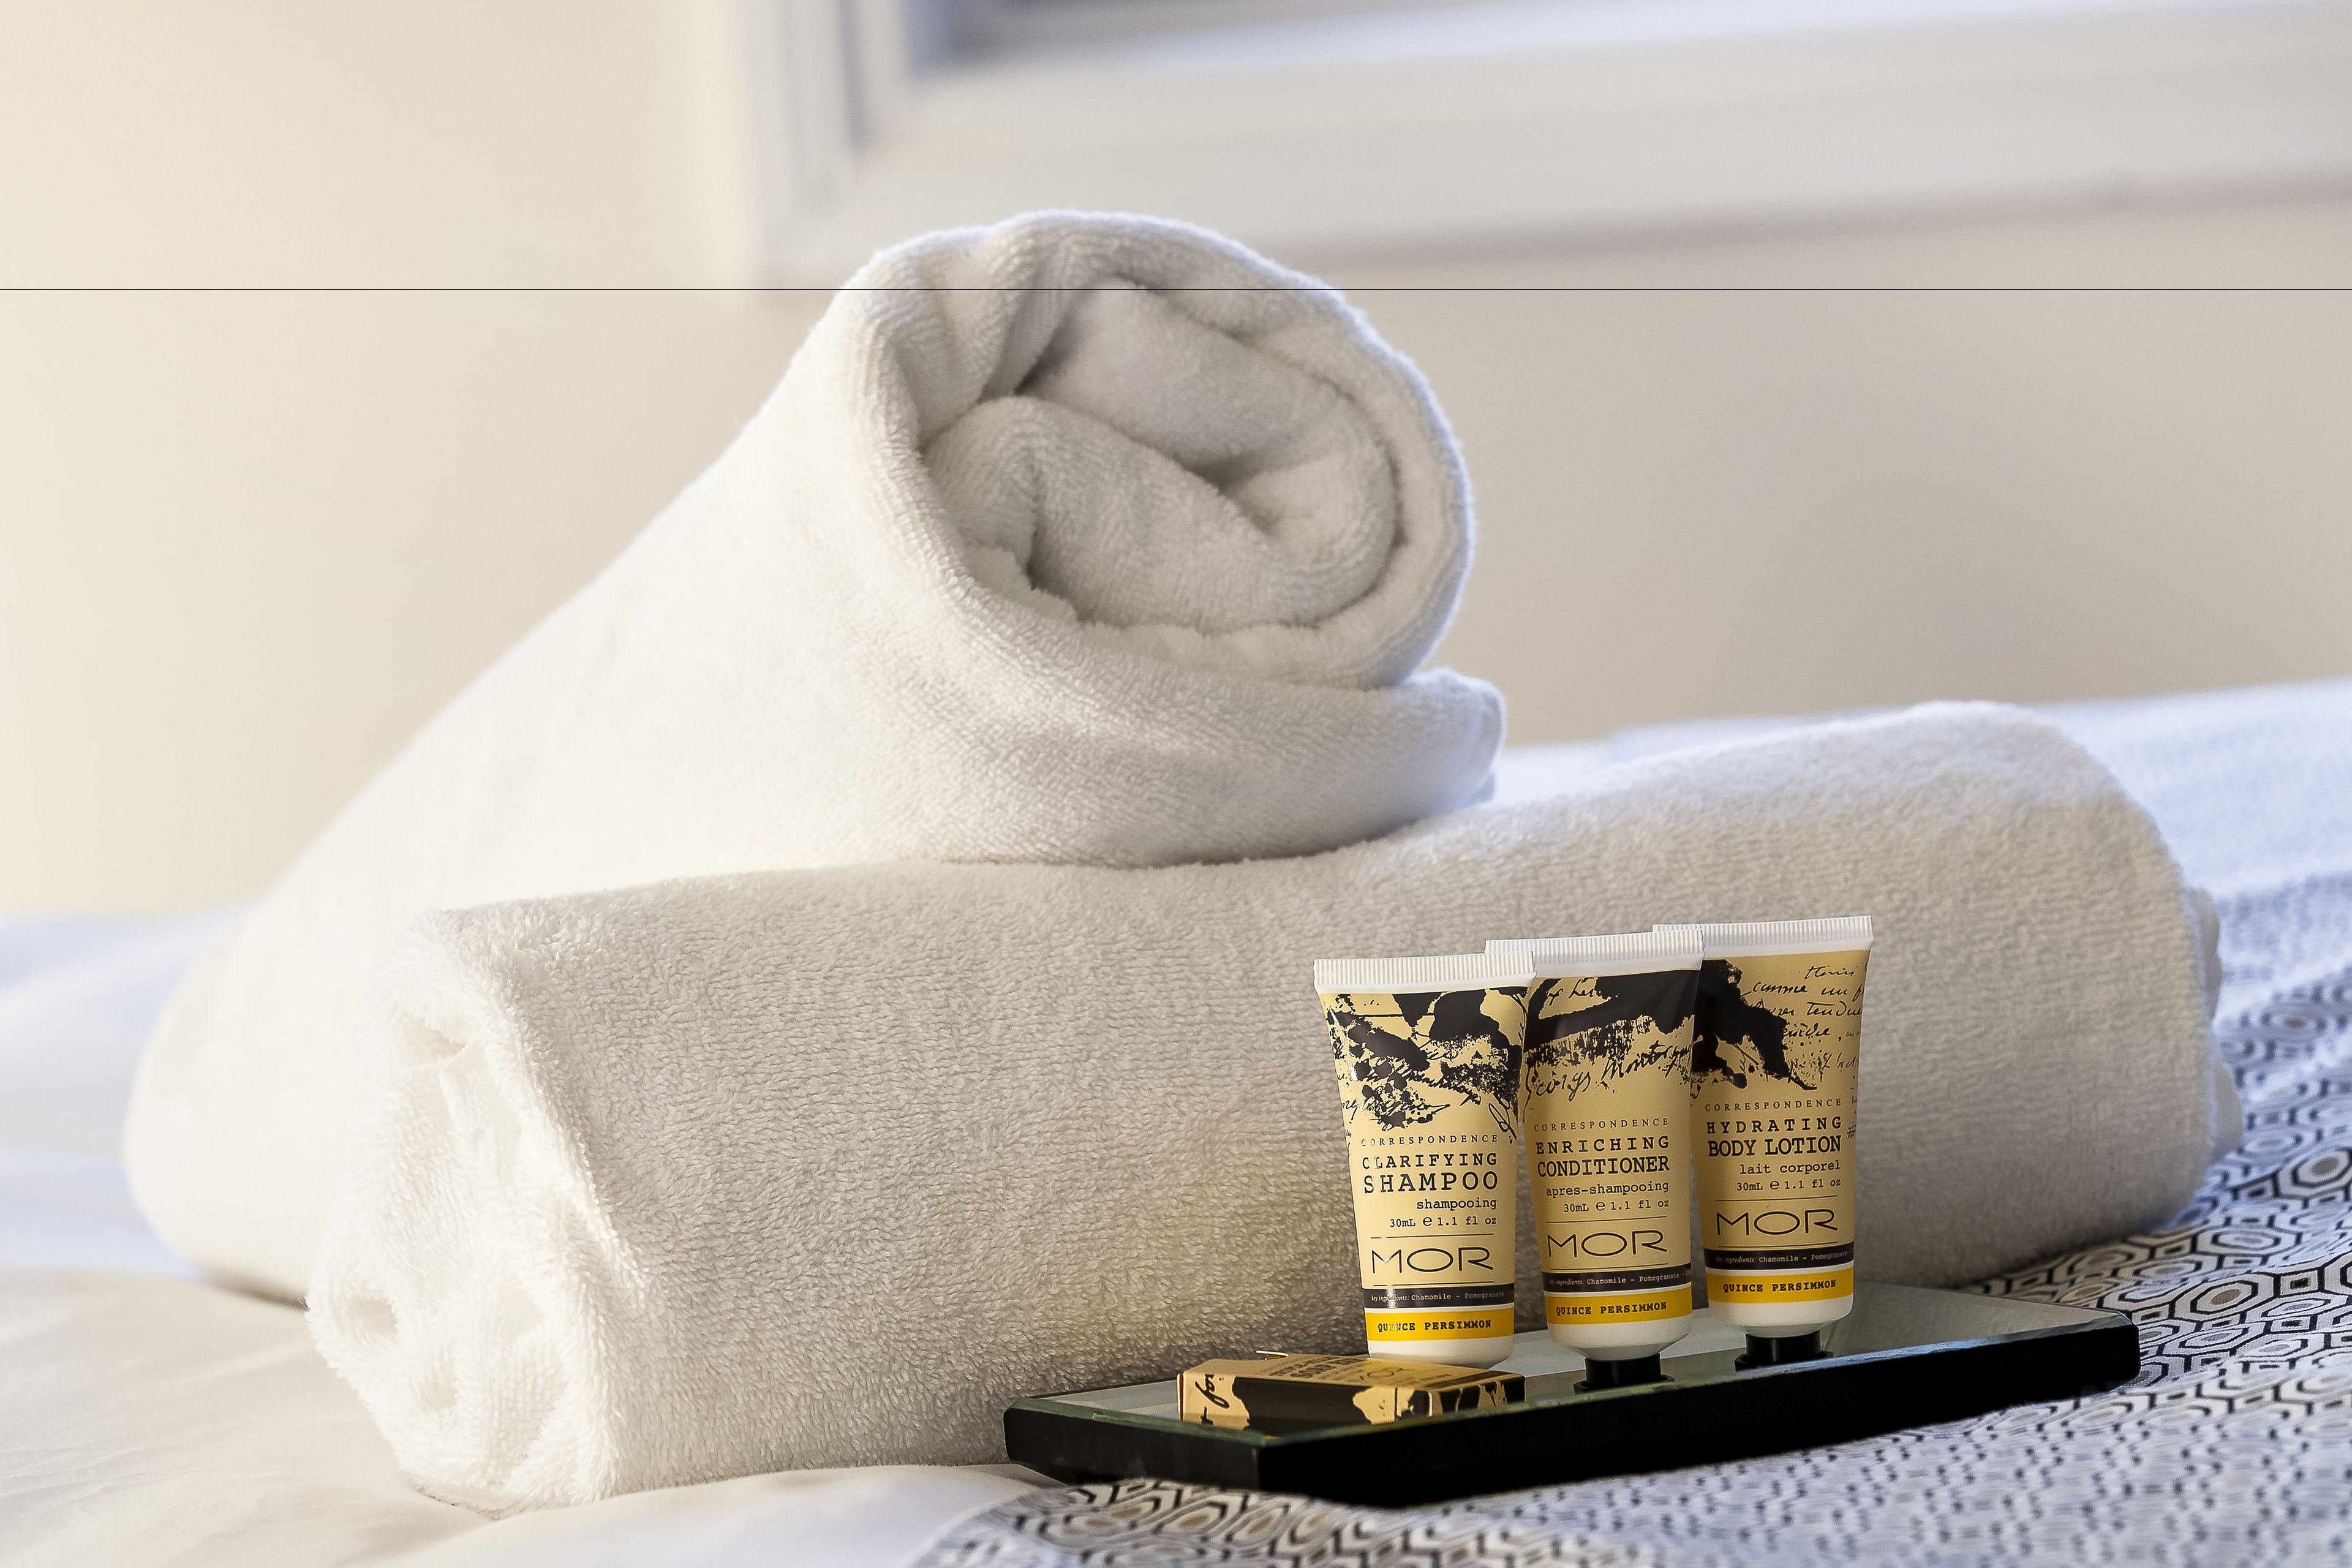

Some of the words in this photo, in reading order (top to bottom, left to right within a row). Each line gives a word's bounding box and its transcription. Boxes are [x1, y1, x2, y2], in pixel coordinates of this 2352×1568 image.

[1705, 1098, 1842, 1112] CORRESPONDENCE
[1534, 1118, 1668, 1132] CORRESPONDENCE
[1706, 1116, 1842, 1134] HYDRATING
[1361, 1134, 1498, 1146] CORRESPONDENCE
[1536, 1135, 1669, 1155] ENRICHING
[1708, 1139, 1757, 1157] BODY
[1765, 1135, 1841, 1155] LOTION
[1362, 1153, 1497, 1169] CLARIFYING
[1538, 1155, 1670, 1177] CONDITIONER
[1740, 1164, 1771, 1175] lait
[1780, 1159, 1841, 1175] corporel
[1364, 1171, 1498, 1194] SHAMPOO
[1546, 1181, 1669, 1198] apres-shampooing
[1736, 1182, 1763, 1191] 30mL
[1785, 1180, 1804, 1189] 1.1
[1812, 1180, 1824, 1188] fl
[1417, 1198, 1497, 1211] shampooing
[1564, 1203, 1589, 1213] 30mL
[1611, 1201, 1630, 1210] 1.1
[1638, 1200, 1651, 1209] fl
[1657, 1200, 1669, 1208] oz
[1390, 1218, 1415, 1227] 30mL
[1438, 1217, 1457, 1226] 1.1
[1466, 1216, 1477, 1225] fl
[1716, 1208, 1838, 1236] MOR
[1547, 1229, 1667, 1258] MOR
[1371, 1246, 1493, 1274] MOR
[1811, 1251, 1847, 1260] Pomegranate
[1723, 1283, 1763, 1293] QUINCE
[1772, 1280, 1836, 1292] PERSIMMON
[1556, 1306, 1591, 1316] QUINCE
[1600, 1302, 1667, 1314] PERSIMMON
[1378, 1322, 1415, 1333] QUINCE
[1425, 1319, 1491, 1330] PERSIMMON
